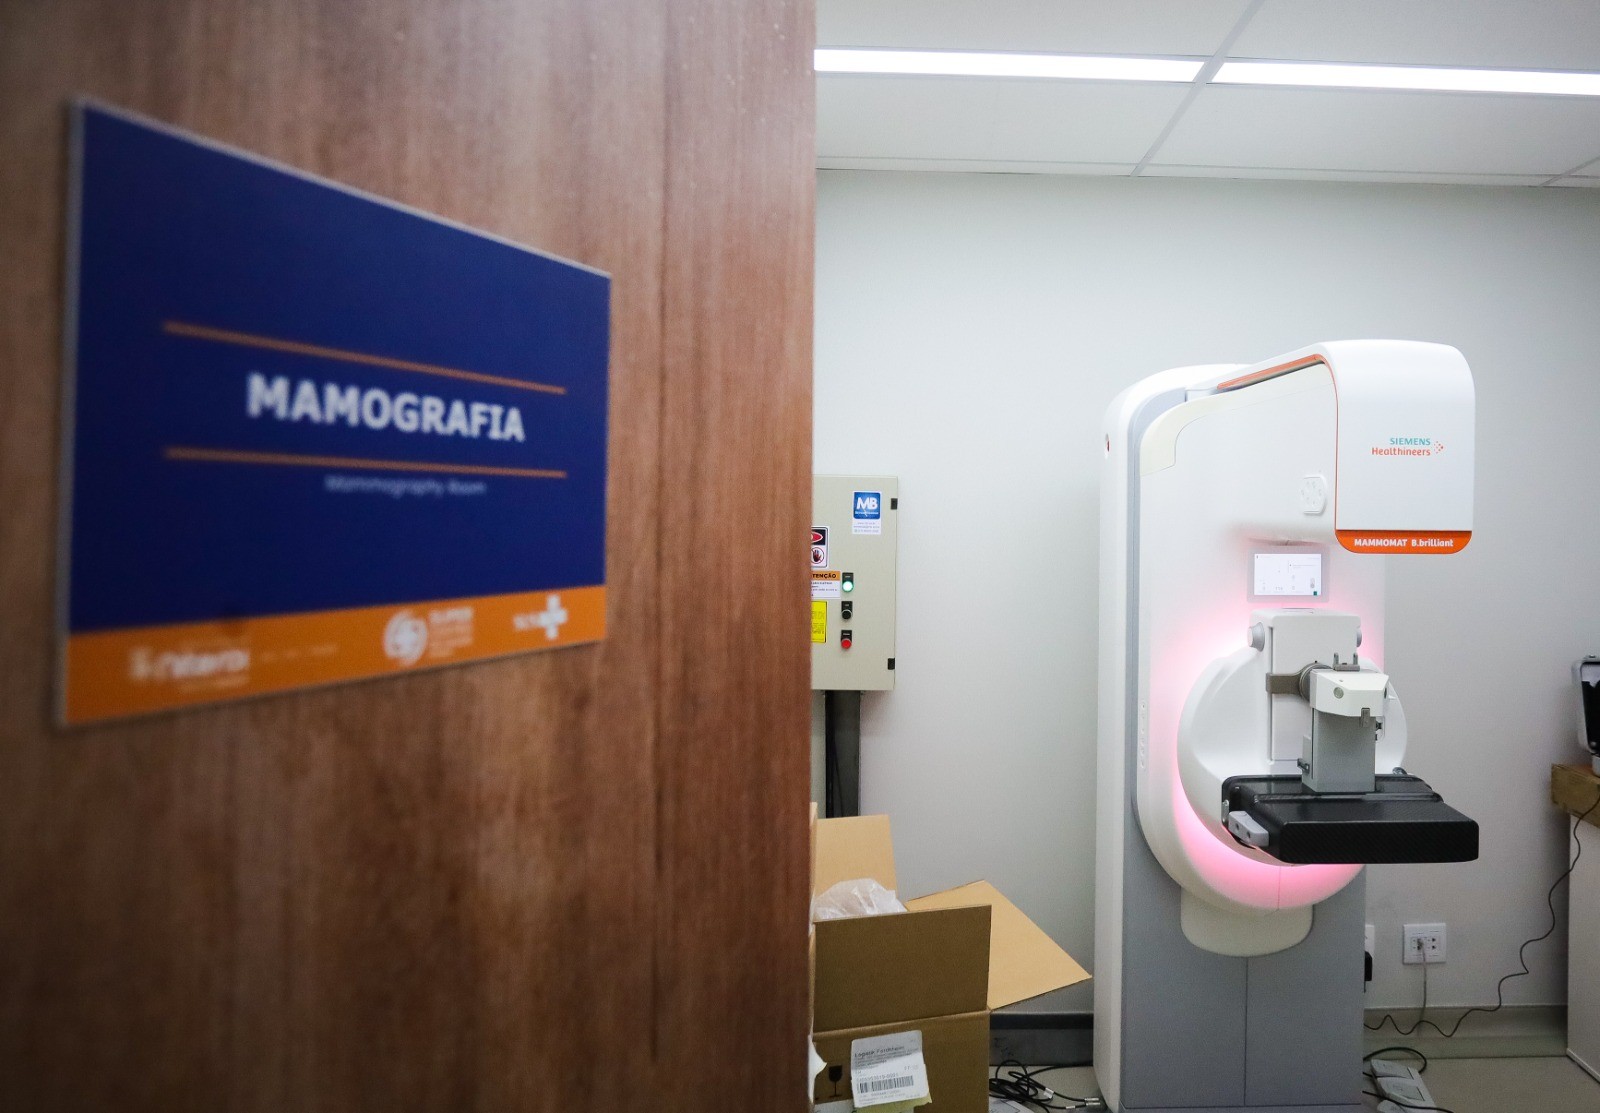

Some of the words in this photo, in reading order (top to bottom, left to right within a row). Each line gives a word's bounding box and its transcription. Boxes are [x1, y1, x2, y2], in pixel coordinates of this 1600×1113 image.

[246, 372, 526, 443] MAMOGRAFIA
[1390, 437, 1431, 446] SIEMENS
[1371, 447, 1431, 456] Healthineers
[856, 497, 878, 510] MB
[1354, 538, 1408, 547] MAMMOMAT
[1411, 538, 1454, 547] B.brilliant
